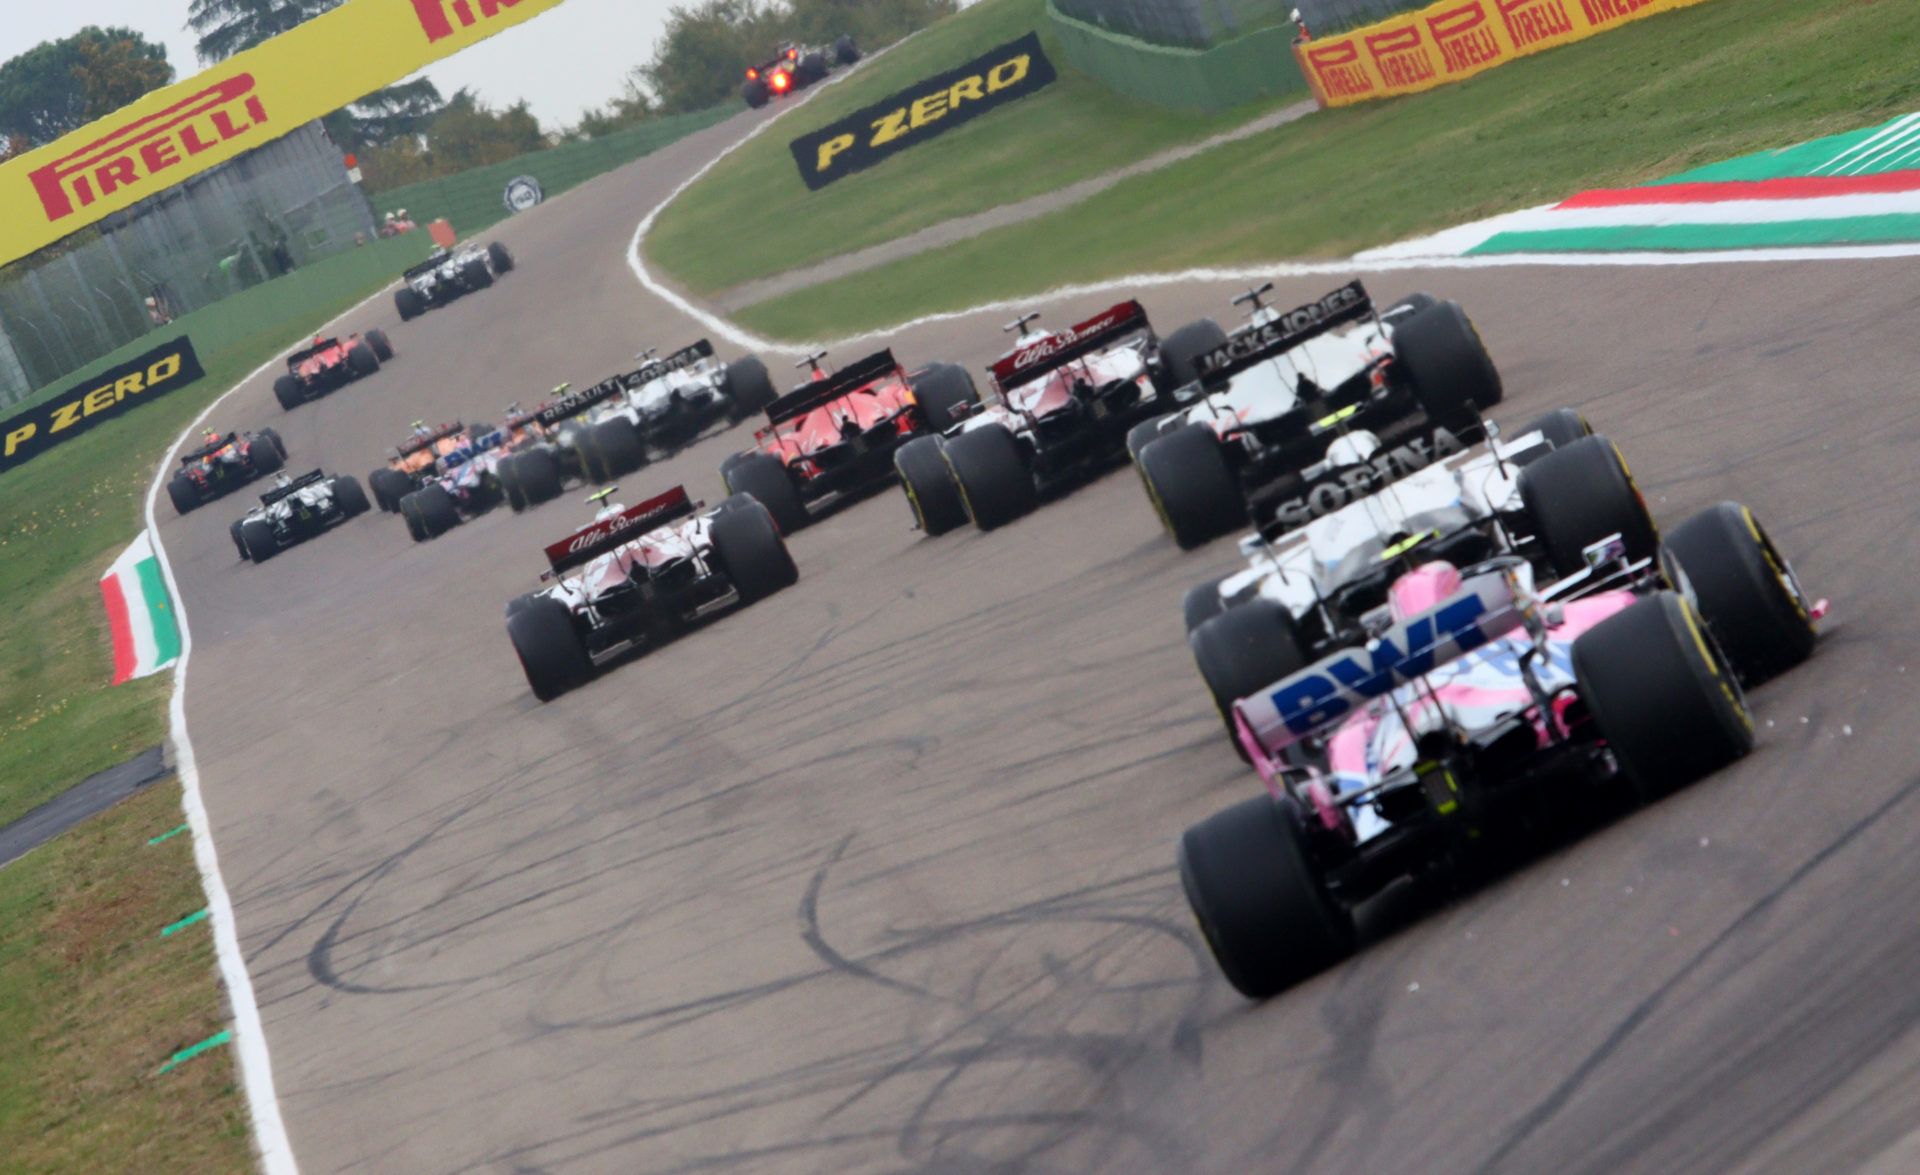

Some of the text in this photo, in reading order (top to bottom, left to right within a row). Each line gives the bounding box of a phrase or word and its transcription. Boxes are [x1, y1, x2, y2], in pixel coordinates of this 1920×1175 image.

[1308, 40, 1374, 98] PIRELLI
[1364, 25, 1436, 88] PIRELLI
[1426, 1, 1501, 73] PIRELLI
[817, 54, 1030, 172] P ZERO
[28, 73, 267, 222] PIRELLI
[1014, 314, 1115, 369] Alfa Romeo
[4, 353, 181, 456] P ZERO
[543, 376, 616, 421] RENAULT
[568, 502, 667, 554] Alfa Romeo
[1270, 593, 1487, 731] BWT
